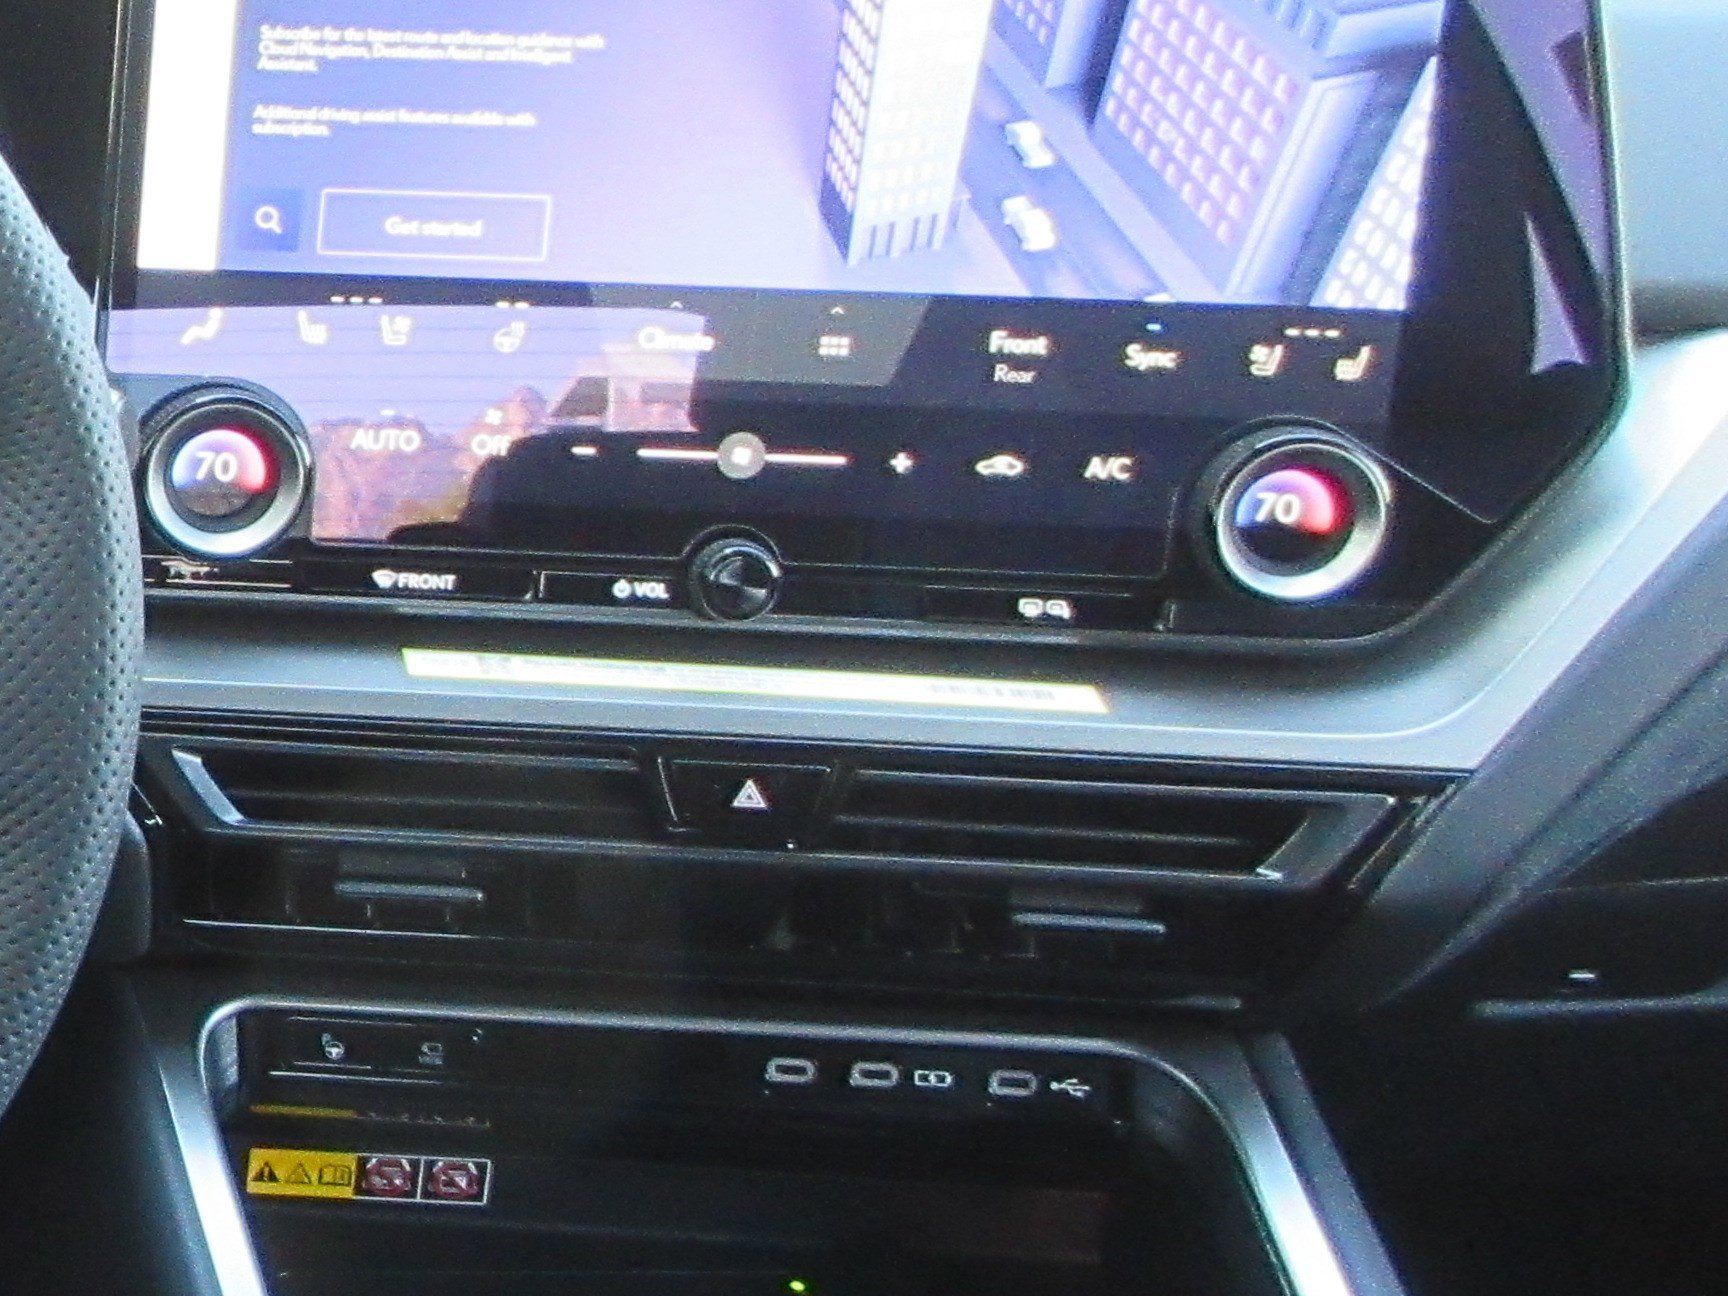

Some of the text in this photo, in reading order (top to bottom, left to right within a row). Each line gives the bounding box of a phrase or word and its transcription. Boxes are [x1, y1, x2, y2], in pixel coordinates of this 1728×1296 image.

[323, 27, 341, 41] for
[345, 28, 363, 42] the
[385, 215, 482, 238] Get started
[638, 327, 715, 352] Climate
[988, 331, 1048, 356] Front
[1124, 344, 1179, 373] Sync
[993, 364, 1035, 384] Rear
[351, 429, 421, 452] AUTO
[471, 433, 511, 456] Off
[196, 451, 237, 482] 70
[1084, 456, 1133, 482] A/C
[1255, 493, 1302, 525] 70
[398, 571, 456, 591] FRONT
[634, 581, 670, 599] VOL
